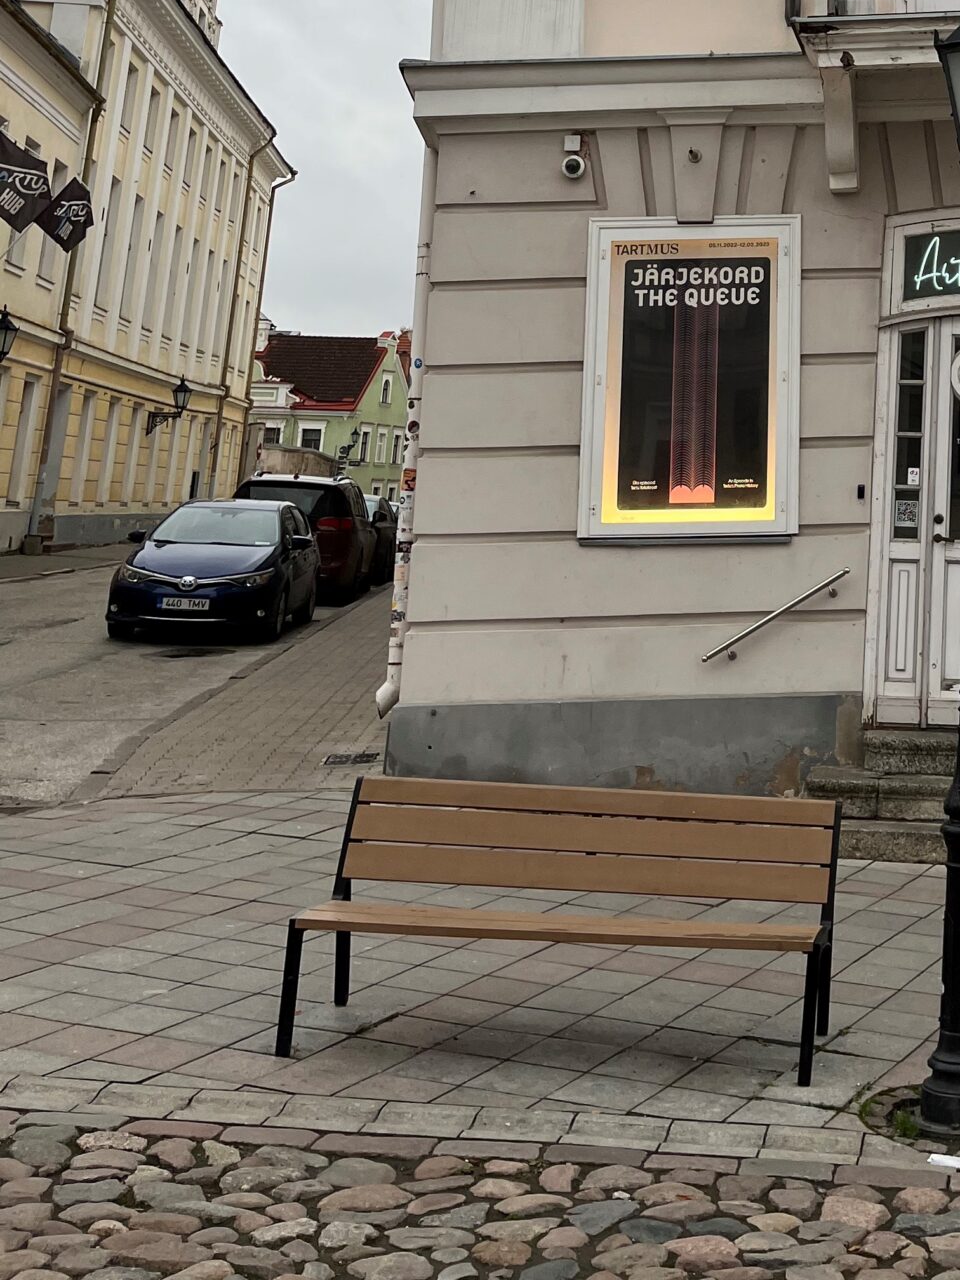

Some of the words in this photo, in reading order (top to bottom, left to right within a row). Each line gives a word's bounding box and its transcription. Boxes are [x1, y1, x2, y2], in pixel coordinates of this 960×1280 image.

[0, 187, 26, 215] HUB
[615, 243, 679, 256] TARTMUS
[631, 264, 765, 286] JÄRJEKORD
[634, 288, 678, 307] THE
[684, 287, 760, 308] QUEUE
[165, 599, 182, 608] 440
[187, 599, 207, 609] TMV
